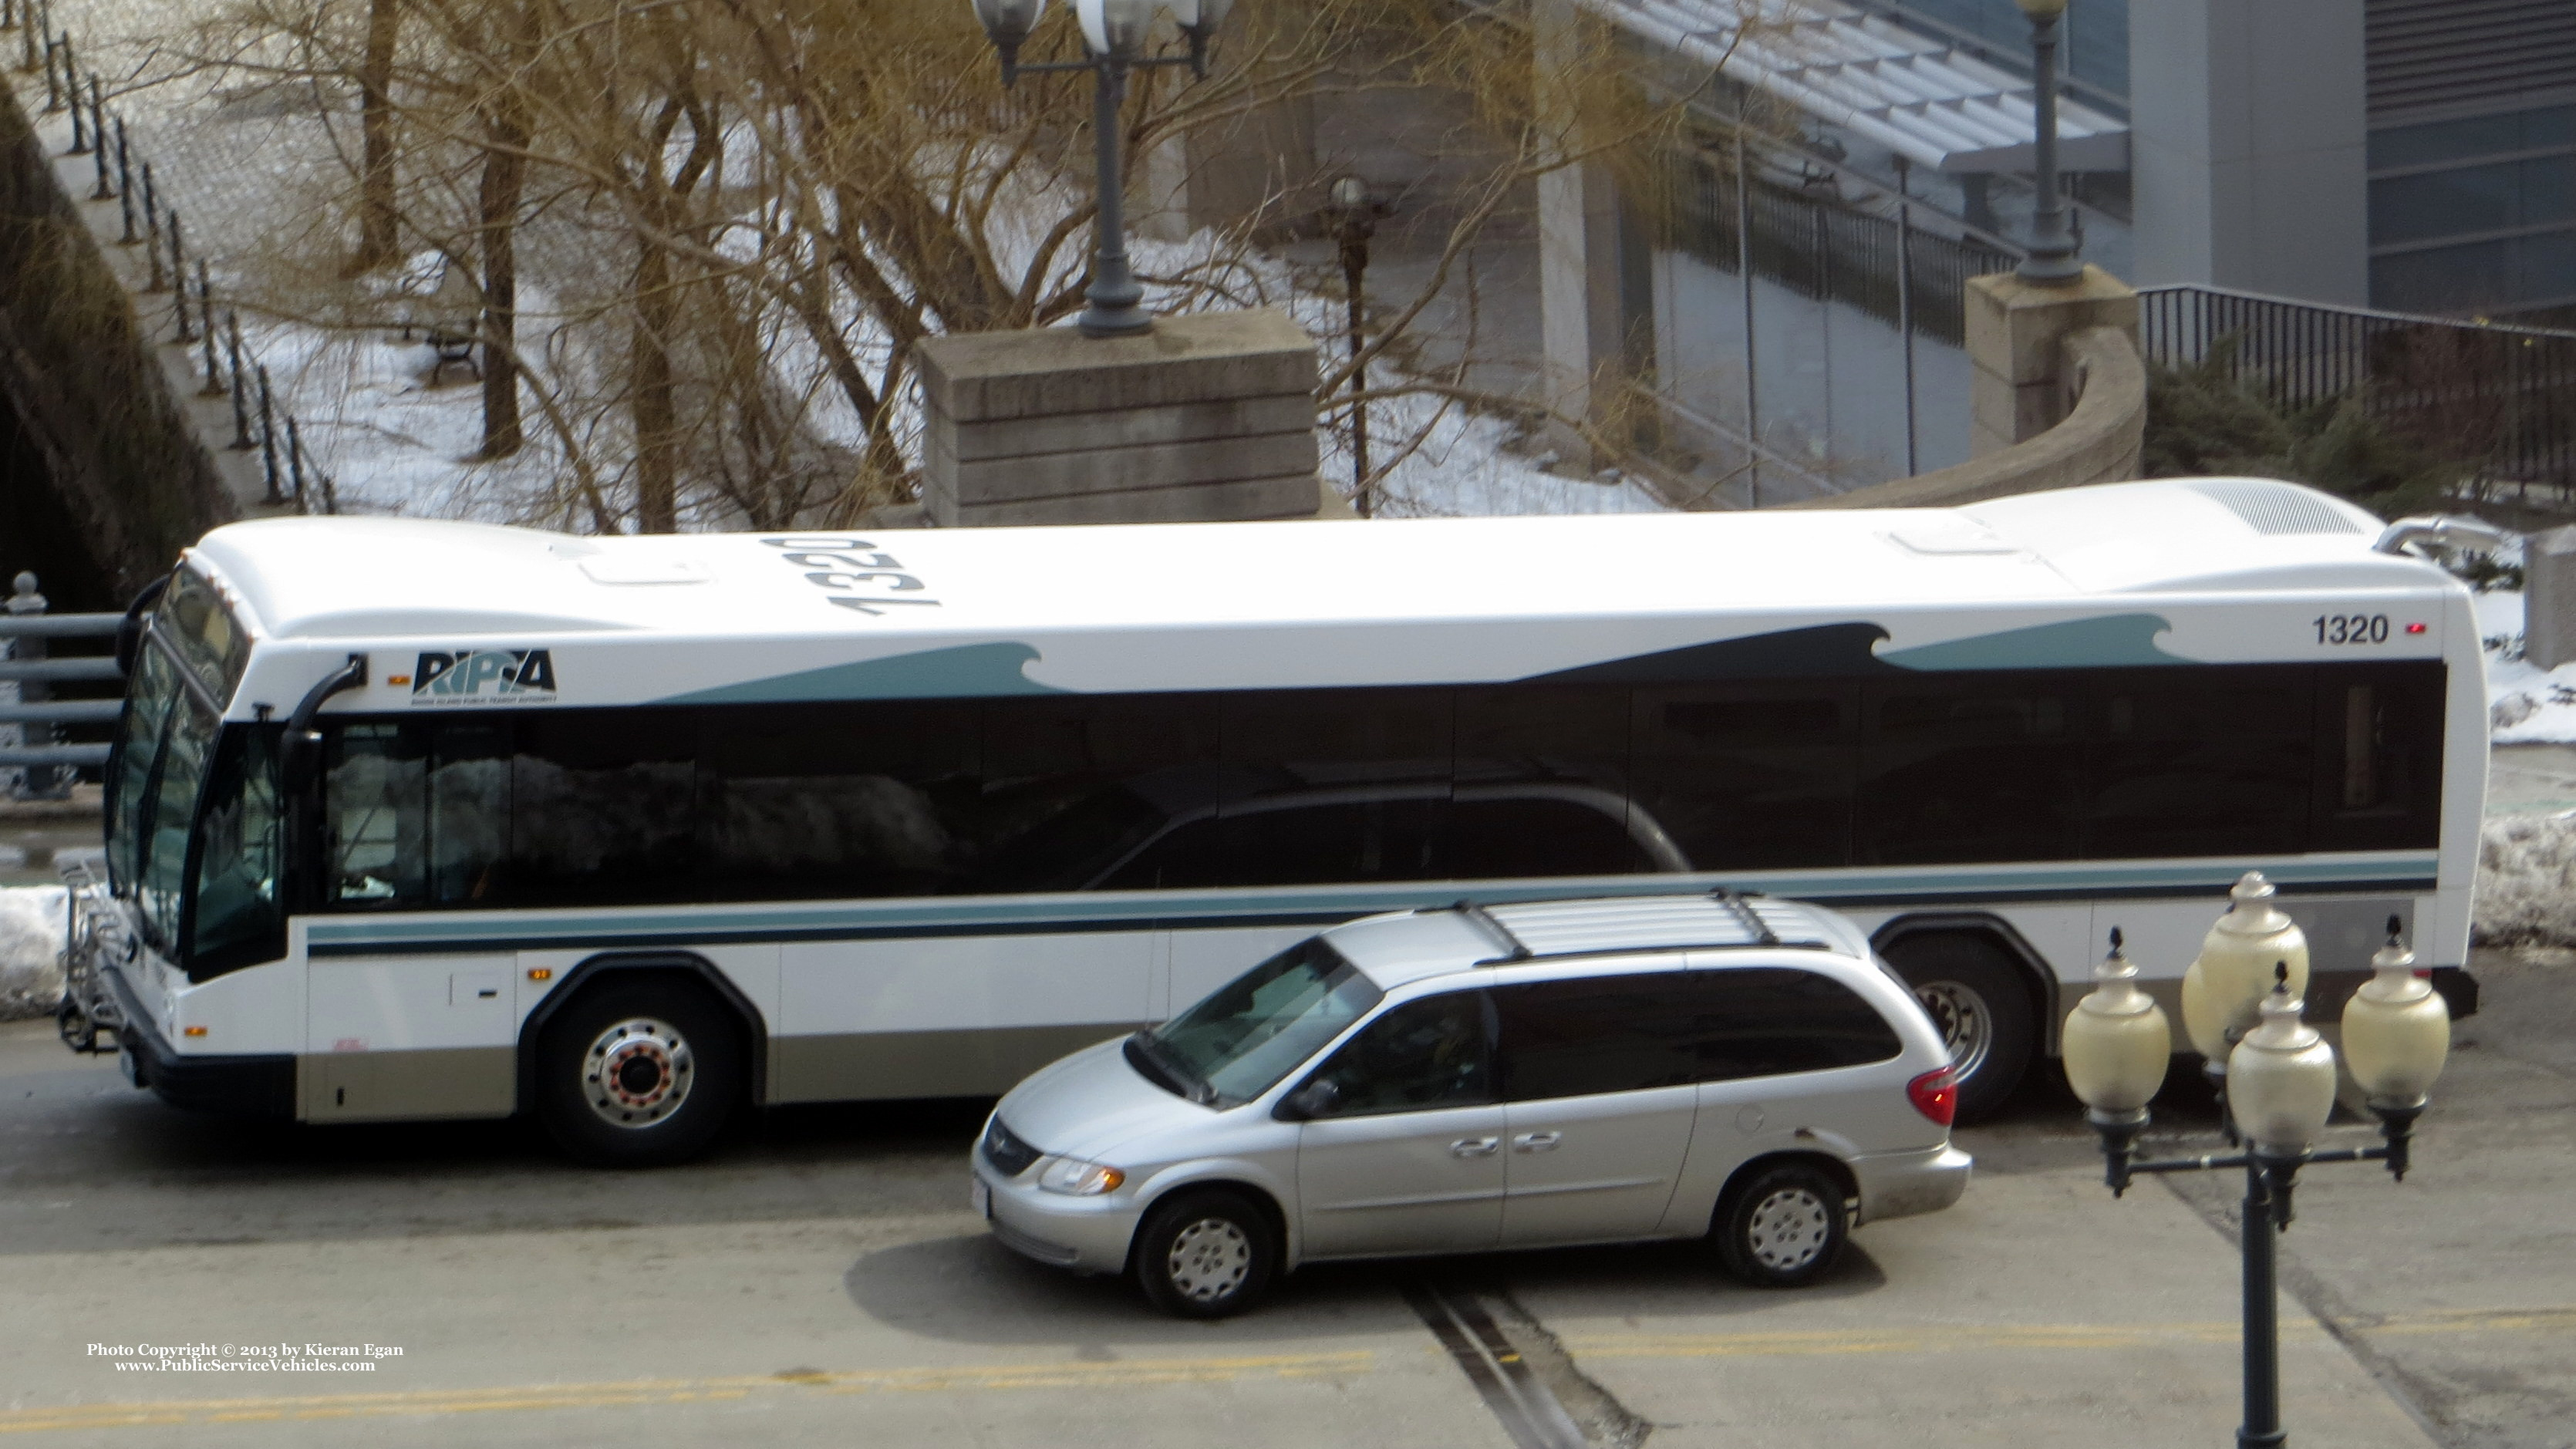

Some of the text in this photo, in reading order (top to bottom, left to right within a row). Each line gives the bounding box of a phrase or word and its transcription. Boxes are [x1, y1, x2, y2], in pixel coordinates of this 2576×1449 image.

[759, 537, 942, 616] 1320
[2312, 614, 2389, 645] 1320
[413, 649, 557, 695] RIPTA
